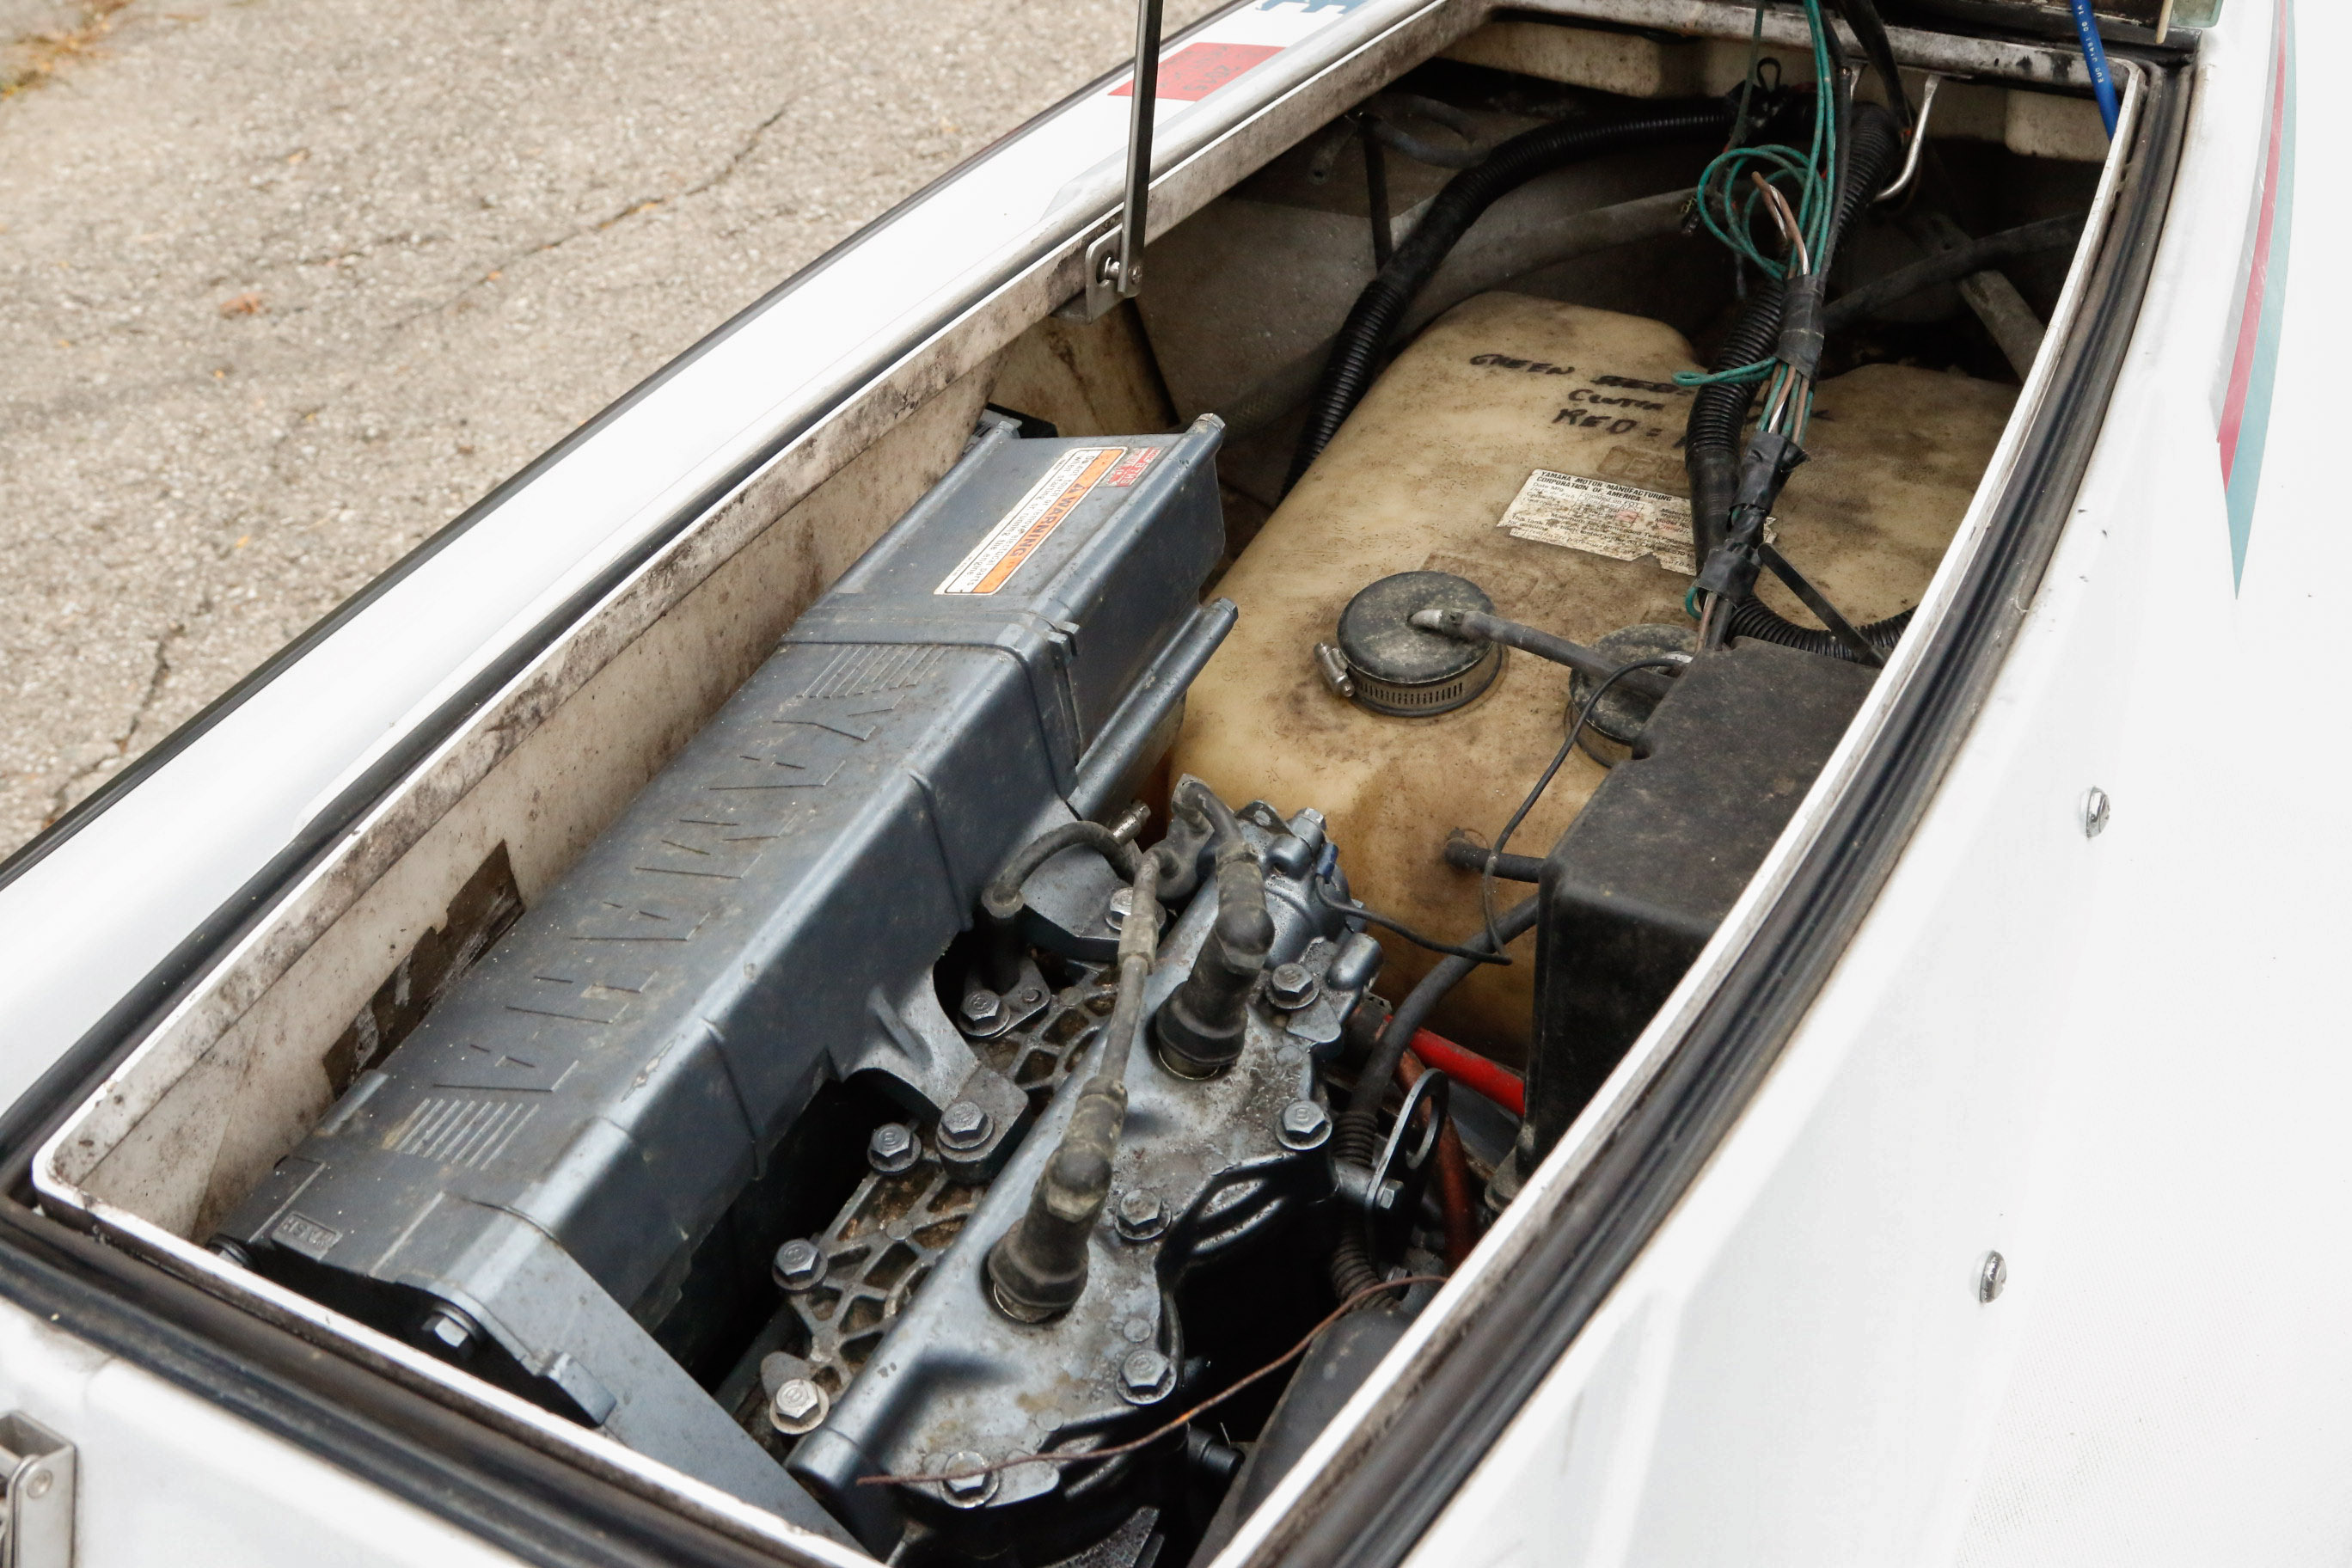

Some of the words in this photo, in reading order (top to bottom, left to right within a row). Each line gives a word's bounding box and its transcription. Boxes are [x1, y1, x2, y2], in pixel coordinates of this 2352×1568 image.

[1063, 456, 1084, 471] when
[1069, 465, 1086, 475] not
[1034, 475, 1066, 499] starting
[1050, 479, 1073, 496] touch
[1535, 475, 1589, 490] CORPORATION
[1605, 490, 1641, 501] AMERICA
[1540, 470, 1572, 481] YAMAHA
[1574, 477, 1603, 487] MOTOR
[1606, 483, 1672, 501] MANUFACTURING
[1001, 513, 1030, 536] running
[1009, 497, 1075, 556] WARNING
[1015, 509, 1044, 531] remove
[984, 535, 1020, 565] electrical
[989, 540, 1006, 549] the
[964, 567, 989, 585] parts
